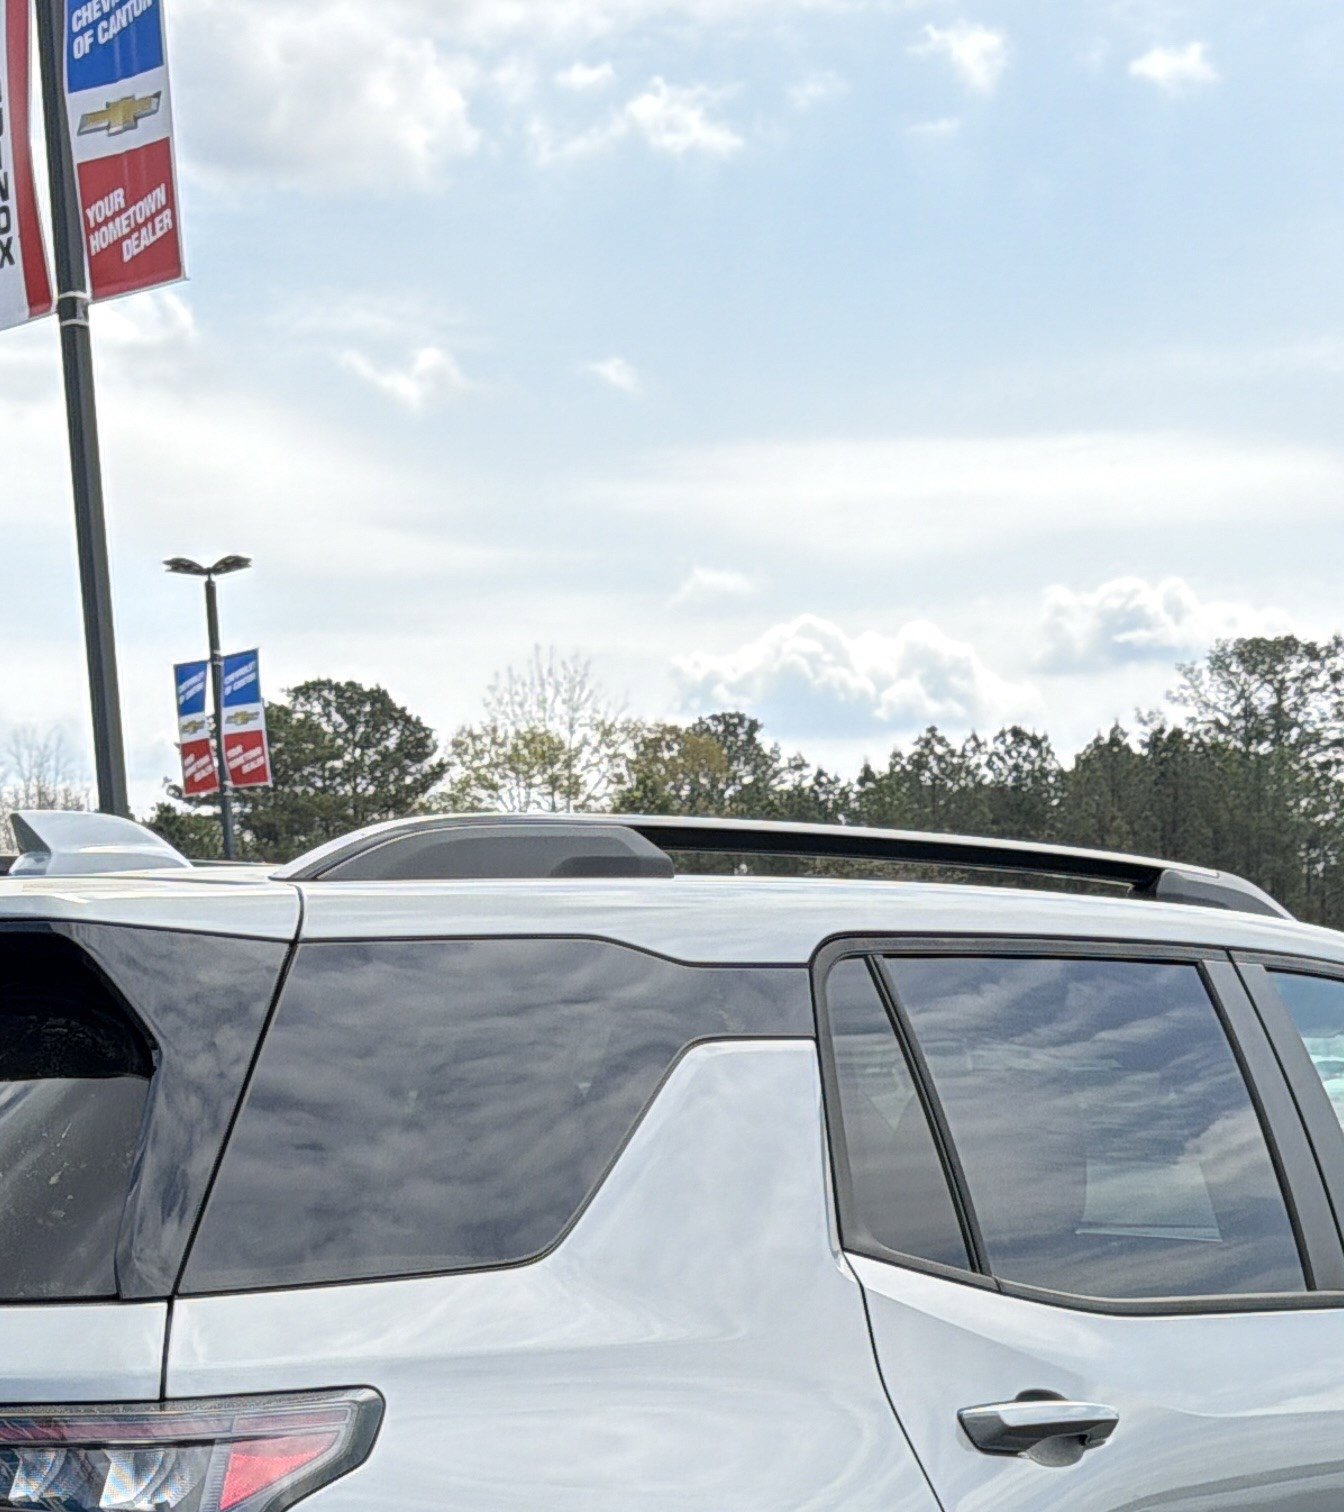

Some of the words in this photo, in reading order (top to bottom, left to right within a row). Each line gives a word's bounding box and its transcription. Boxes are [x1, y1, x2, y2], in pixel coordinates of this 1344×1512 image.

[73, 29, 94, 59] OF
[85, 187, 125, 229] YOUR
[89, 183, 166, 256] HOMETOWN
[122, 208, 173, 263] DEALER
